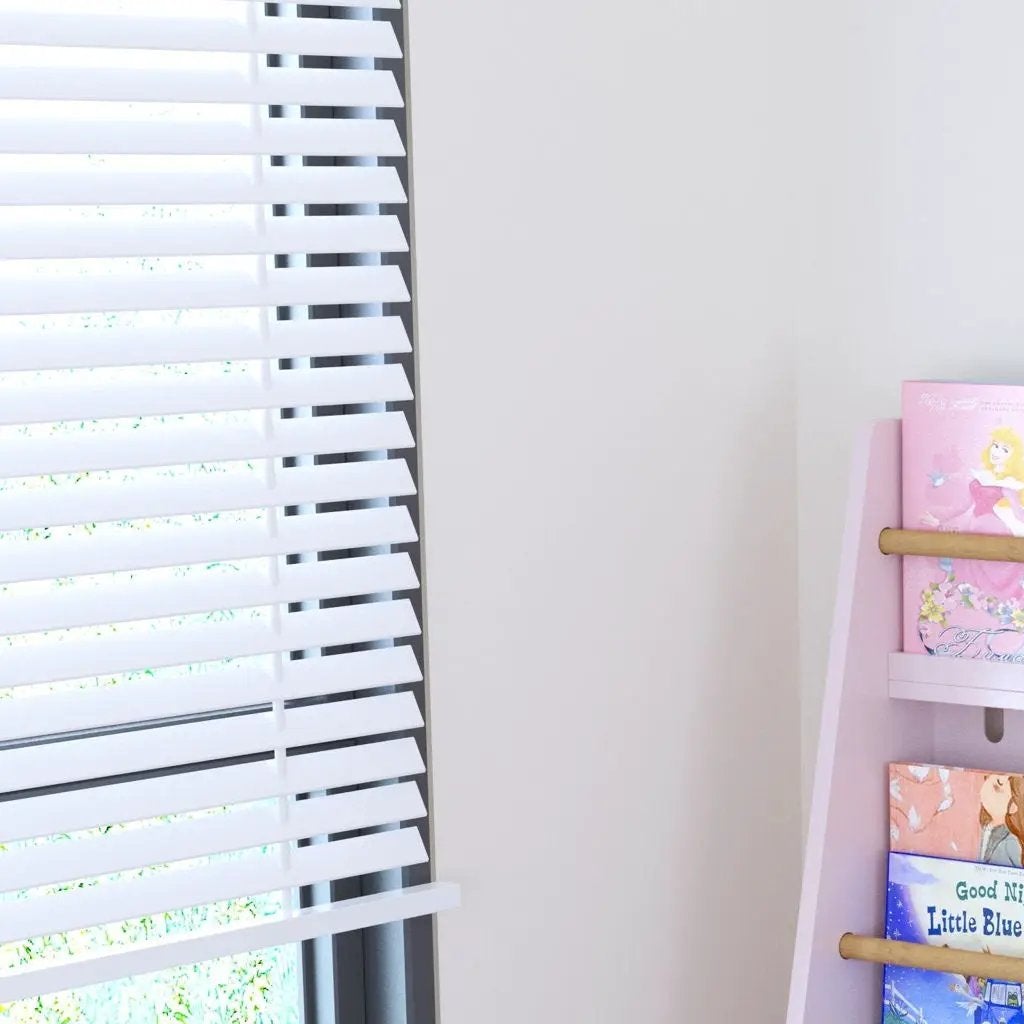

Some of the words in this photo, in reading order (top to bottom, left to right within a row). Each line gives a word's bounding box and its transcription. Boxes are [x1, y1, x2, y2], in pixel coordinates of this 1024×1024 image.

[955, 880, 998, 901] Good
[927, 906, 977, 936] Little
[982, 907, 1022, 938] Blue
